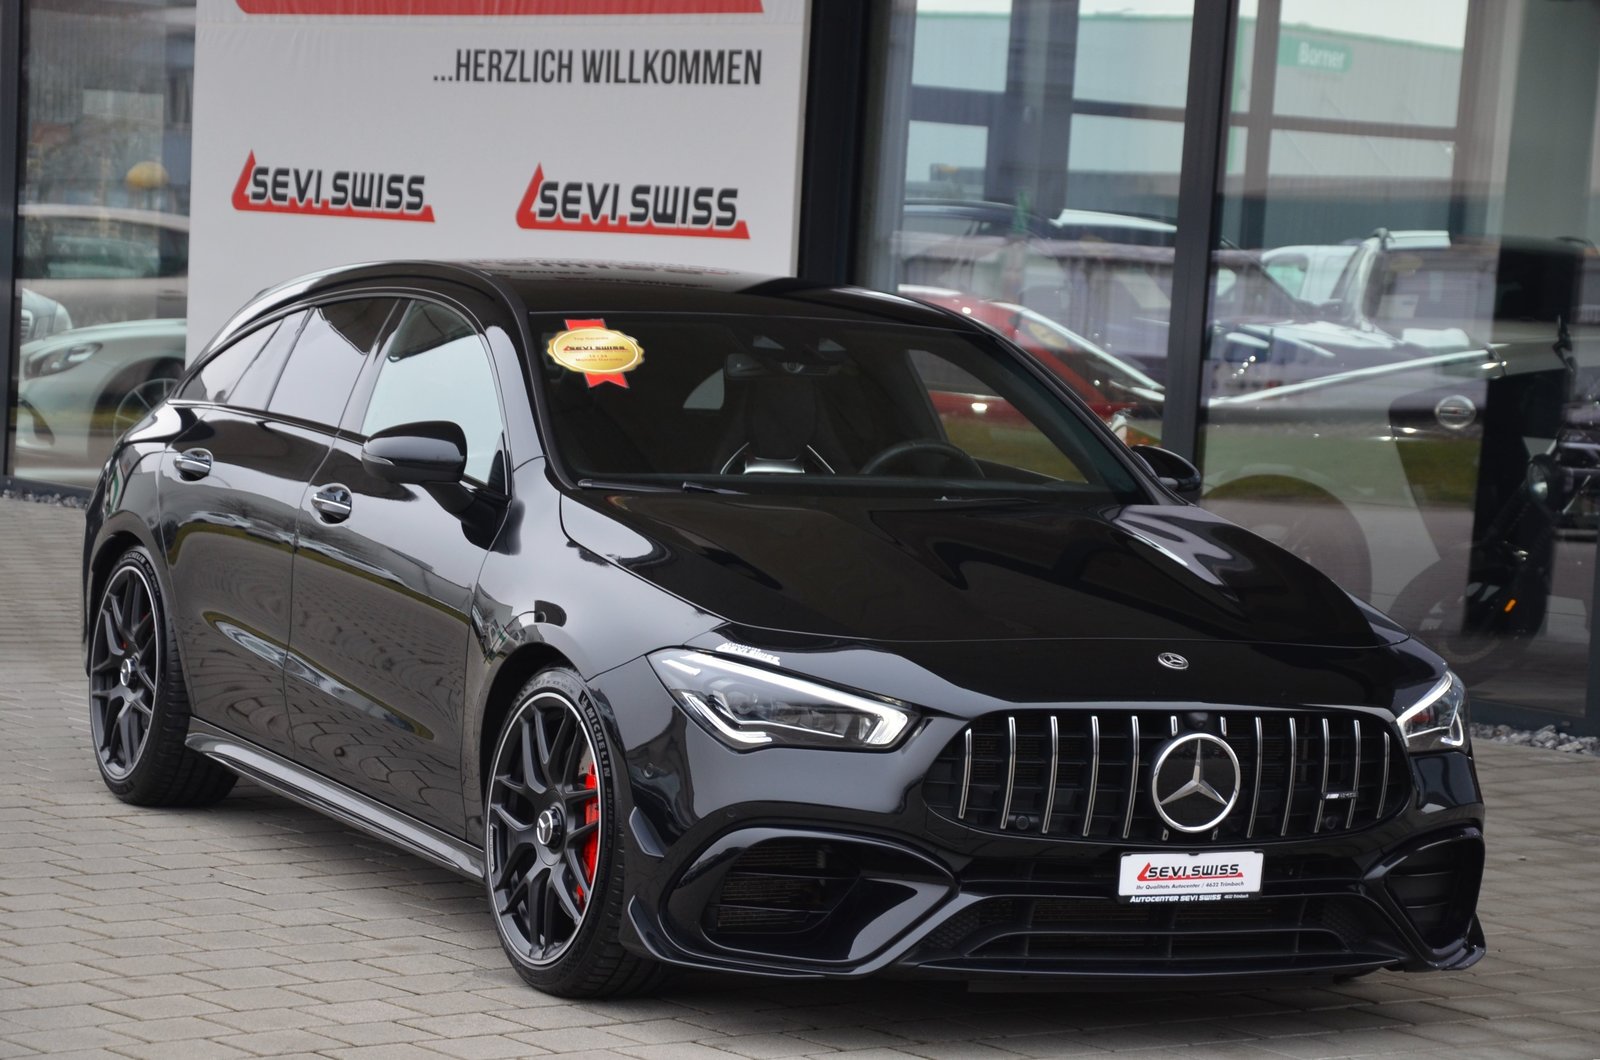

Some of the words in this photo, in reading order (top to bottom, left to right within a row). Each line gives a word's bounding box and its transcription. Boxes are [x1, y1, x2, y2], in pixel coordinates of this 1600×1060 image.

[582, 48, 763, 86] WILLKOMMEN
[250, 166, 323, 204] SEVI
[331, 170, 426, 212] SWISS
[538, 181, 621, 221] SEVI
[628, 184, 739, 227] SWISS
[585, 708, 611, 778] MICHELIN
[1147, 866, 1187, 878] SEVI
[1191, 864, 1240, 876] SWISS
